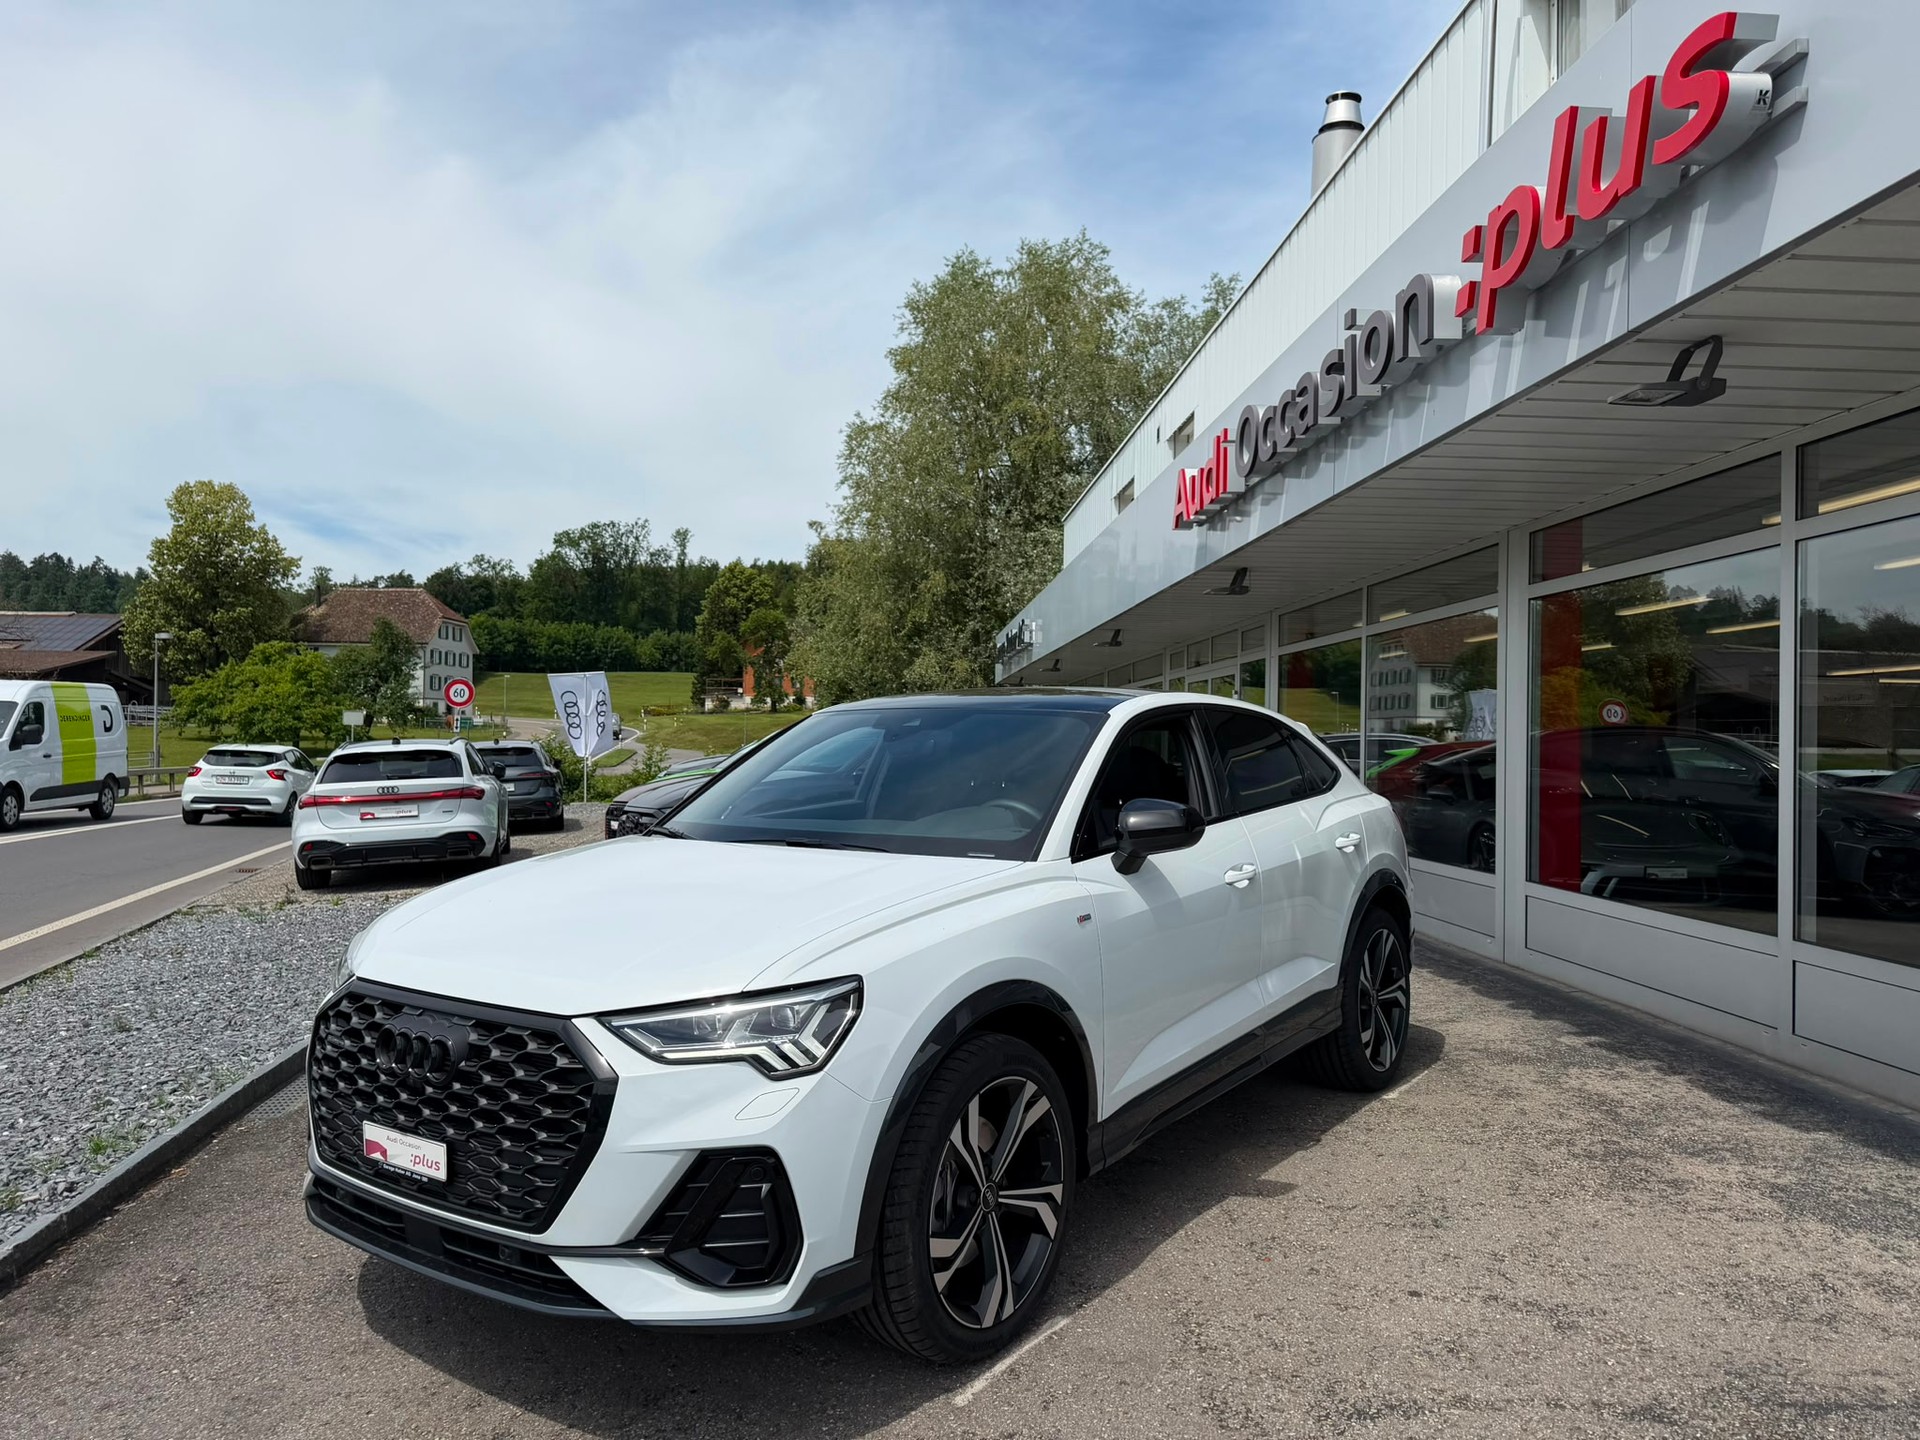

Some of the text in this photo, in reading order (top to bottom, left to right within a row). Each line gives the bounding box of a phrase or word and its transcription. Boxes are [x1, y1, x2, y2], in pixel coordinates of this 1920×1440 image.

[1757, 89, 1770, 105] K
[1172, 12, 1737, 530] Audi Occasion :plus
[453, 688, 466, 699] 60
[386, 1135, 422, 1150] Audi Occasion
[410, 1154, 440, 1171] :plus
